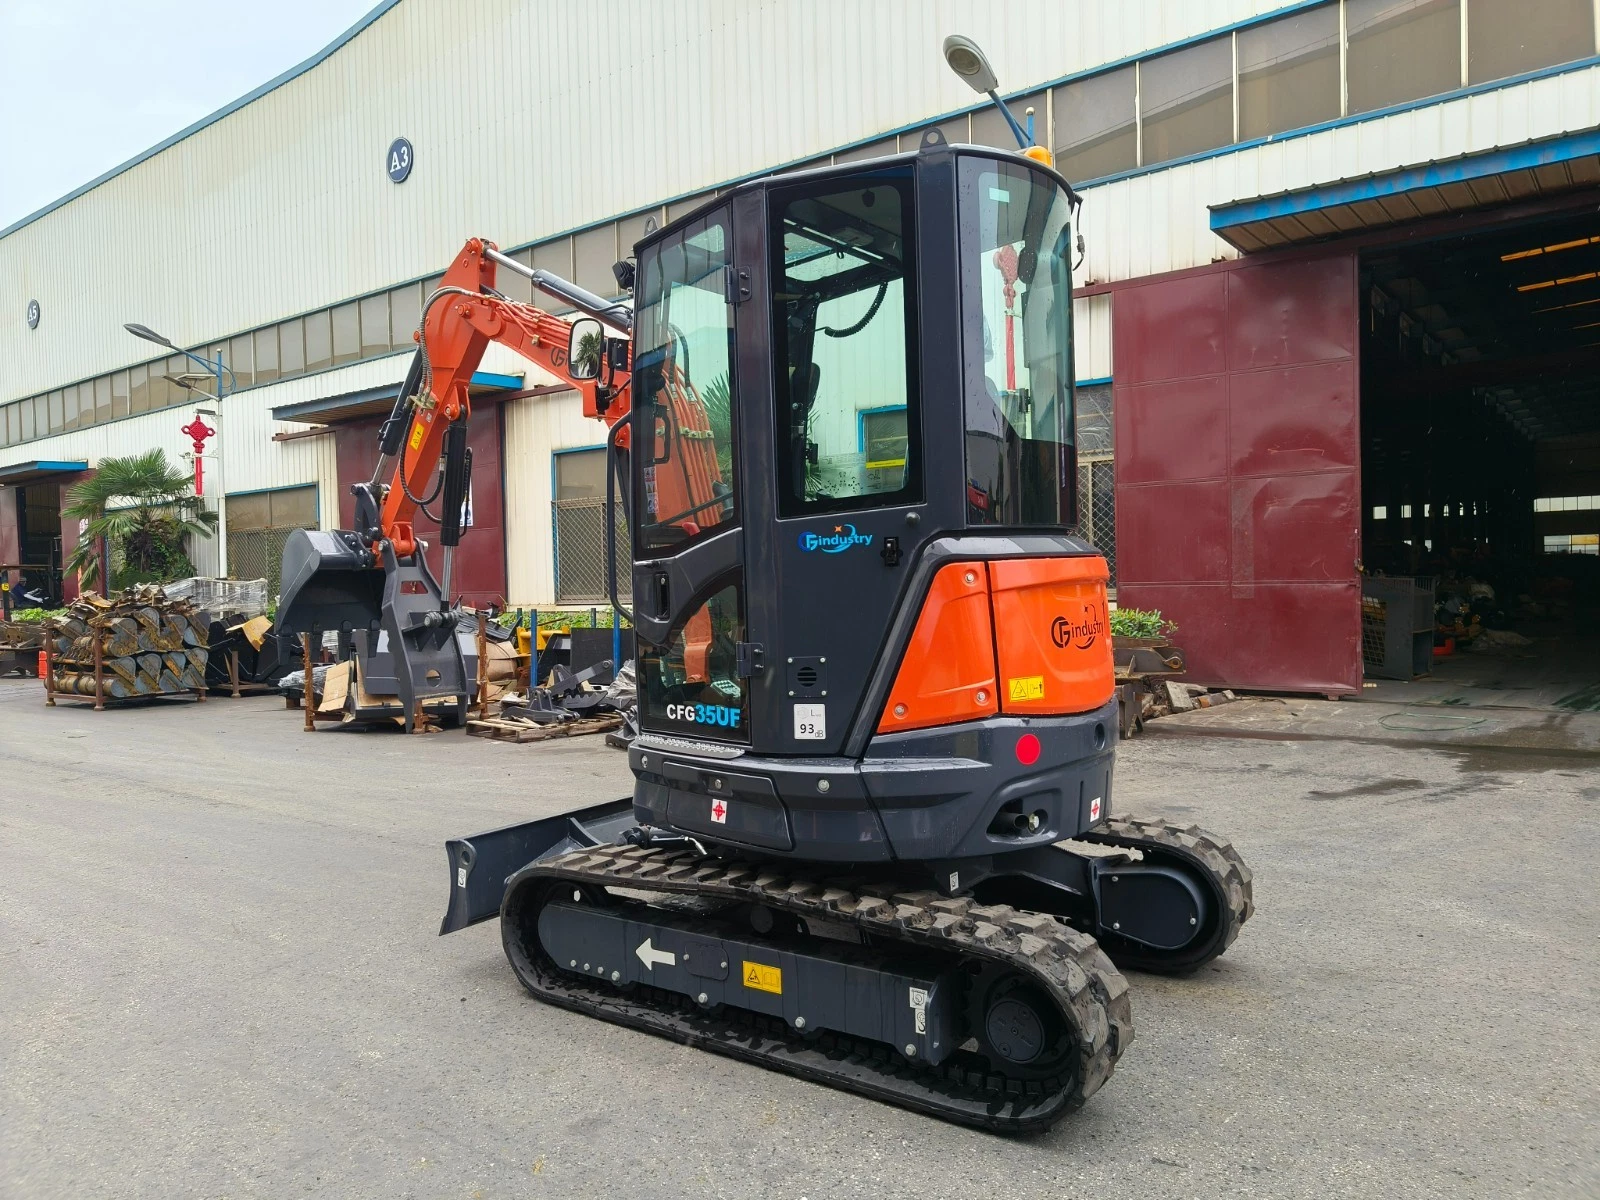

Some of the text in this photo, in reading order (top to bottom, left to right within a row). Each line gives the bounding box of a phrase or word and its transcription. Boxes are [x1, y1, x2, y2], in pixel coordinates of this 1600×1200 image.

[390, 146, 409, 173] A3
[28, 305, 37, 321] A5
[666, 704, 741, 727] CFG35UF
[800, 723, 815, 734] 93
